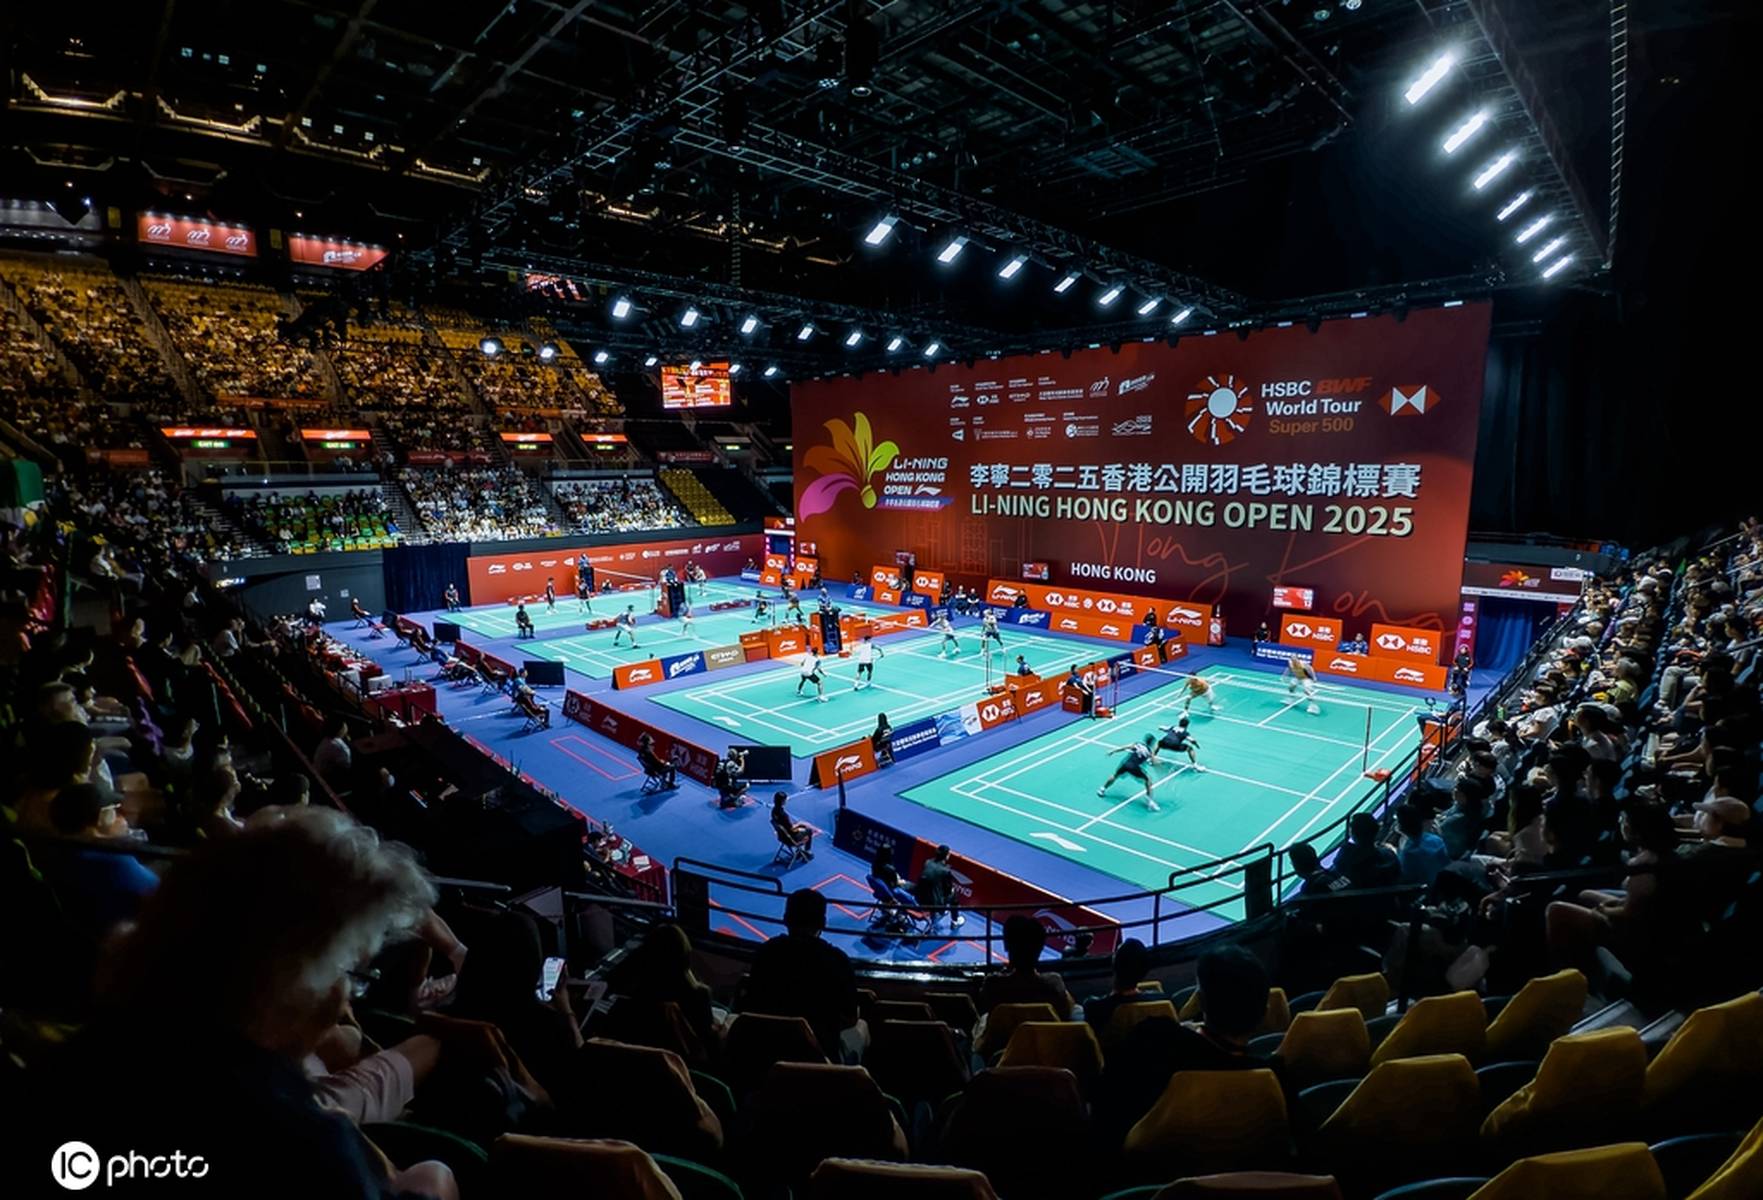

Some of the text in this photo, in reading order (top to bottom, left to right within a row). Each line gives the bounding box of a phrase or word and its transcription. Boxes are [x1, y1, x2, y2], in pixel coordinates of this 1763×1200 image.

[1261, 376, 1372, 398] HSBC BWF
[1266, 399, 1362, 416] World Tour
[1269, 417, 1354, 436] Super 500
[893, 457, 948, 470] LI-NING
[885, 472, 945, 482] HONG KONG
[970, 463, 1421, 498] 李寧二零二五香港公開羽毛球錦標賽
[883, 485, 911, 495] OPEN
[971, 494, 1414, 537] LI-NING HONG KONG OPEN 2025
[1071, 562, 1156, 583] HONG KONG
